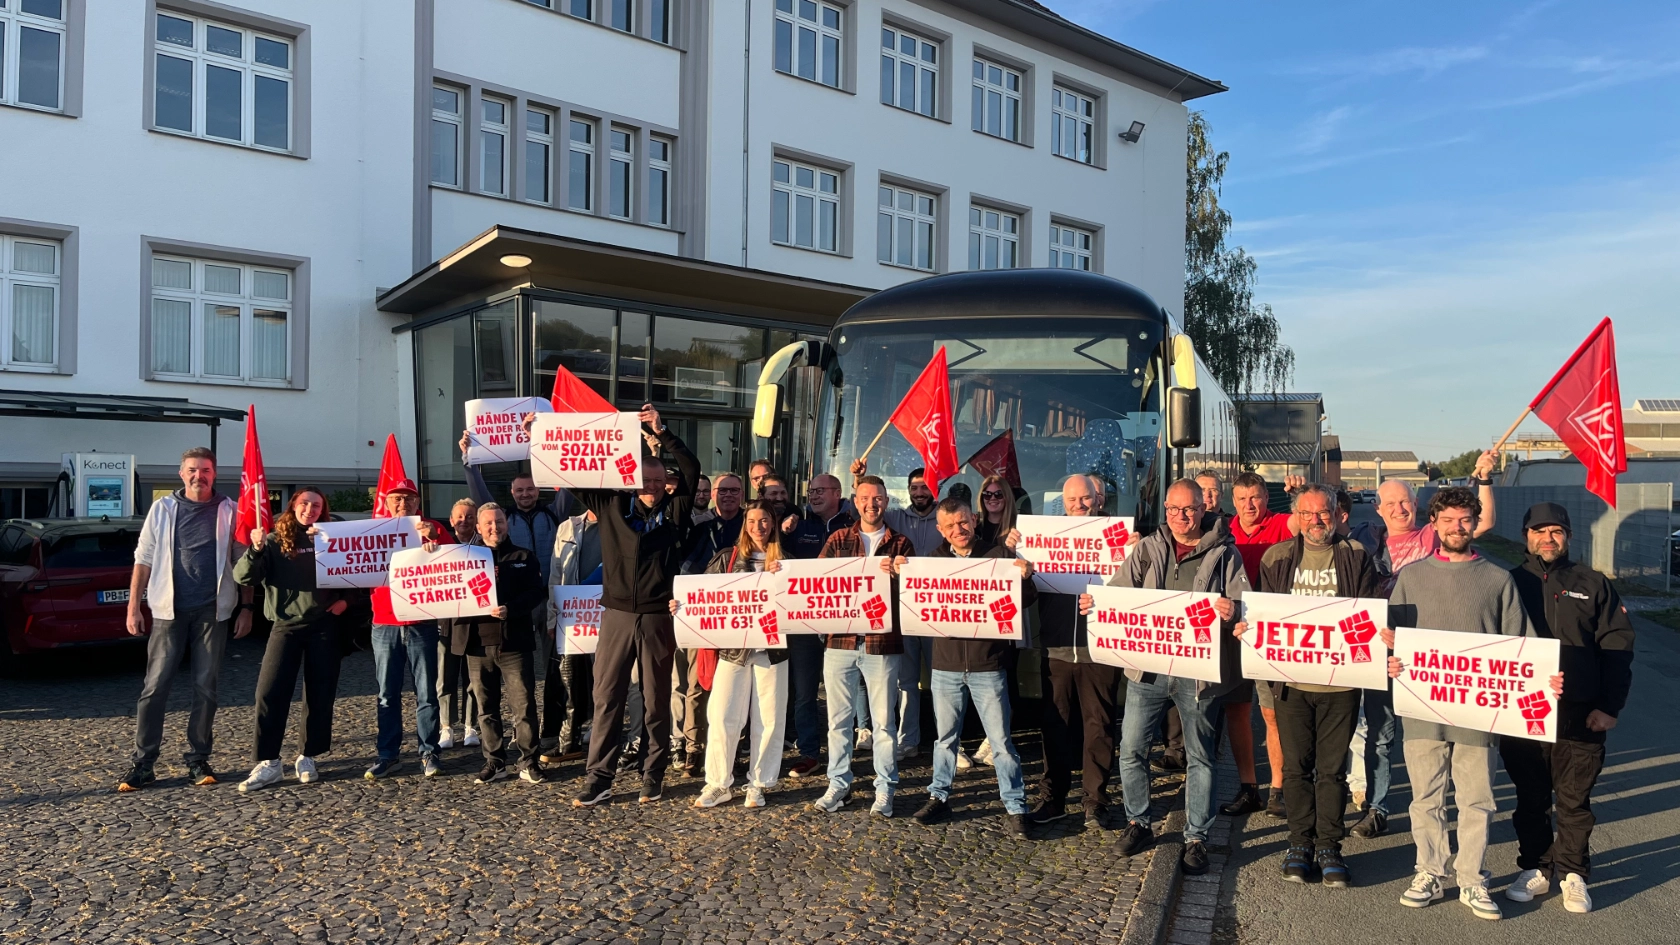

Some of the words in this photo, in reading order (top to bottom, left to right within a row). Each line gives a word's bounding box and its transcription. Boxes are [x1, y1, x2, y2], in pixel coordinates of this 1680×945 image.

[476, 412, 517, 425] HÄNDE
[475, 427, 494, 435] VON
[496, 425, 513, 433] DER
[545, 427, 591, 442] HÄNDE
[594, 429, 624, 442] WEG
[489, 433, 512, 446] MIT
[541, 443, 559, 451] VOM
[561, 443, 619, 457] SOZIAL-
[559, 457, 607, 471] STAAT
[327, 532, 409, 554] ZUKUNFT
[1025, 533, 1070, 549] HÄNDE
[1073, 537, 1103, 551] WEG
[345, 550, 388, 565] STATT
[1048, 550, 1073, 561] VON
[1076, 551, 1100, 562] DER
[393, 559, 487, 578] ZUSAMMENHALT
[1031, 561, 1121, 575] LTERSTEILZEIT
[402, 578, 419, 589] IST
[421, 573, 464, 587] UNSERE
[1293, 567, 1338, 586] MUST
[787, 575, 875, 595] ZUKUNFT
[905, 577, 1013, 592] ZUSAMMENHALT
[104, 591, 118, 601] PB
[408, 587, 467, 605] STÄRKE!
[562, 597, 602, 610] HÄNDE
[687, 588, 734, 604] HÄNDE
[737, 589, 769, 603] WEG
[806, 595, 852, 609] STATT
[914, 592, 934, 603] IST
[937, 592, 985, 604] UNSERE
[685, 606, 706, 616] VON
[708, 605, 729, 615] DER
[731, 604, 764, 614] RENTE
[787, 609, 861, 620] KAHLSCHLAG!
[920, 605, 988, 624] STÄRKE!
[700, 616, 727, 630] MIT
[730, 615, 754, 629] 63!
[1097, 607, 1148, 627] HÄNDE
[1152, 614, 1185, 630] WEG
[1124, 627, 1152, 640] VON
[1156, 630, 1183, 643] DER
[1253, 620, 1336, 650] JETZT
[1096, 637, 1211, 660] ALTERSTEILZEIT!
[1266, 647, 1346, 666] REICHT'S!
[1412, 648, 1482, 674] HÄNDE
[1488, 658, 1534, 678] WEG
[1409, 668, 1440, 683] VON
[1443, 672, 1473, 687] DER
[1477, 676, 1526, 692] RENTE
[1430, 685, 1470, 704] MIT
[1475, 690, 1509, 710] 63!
